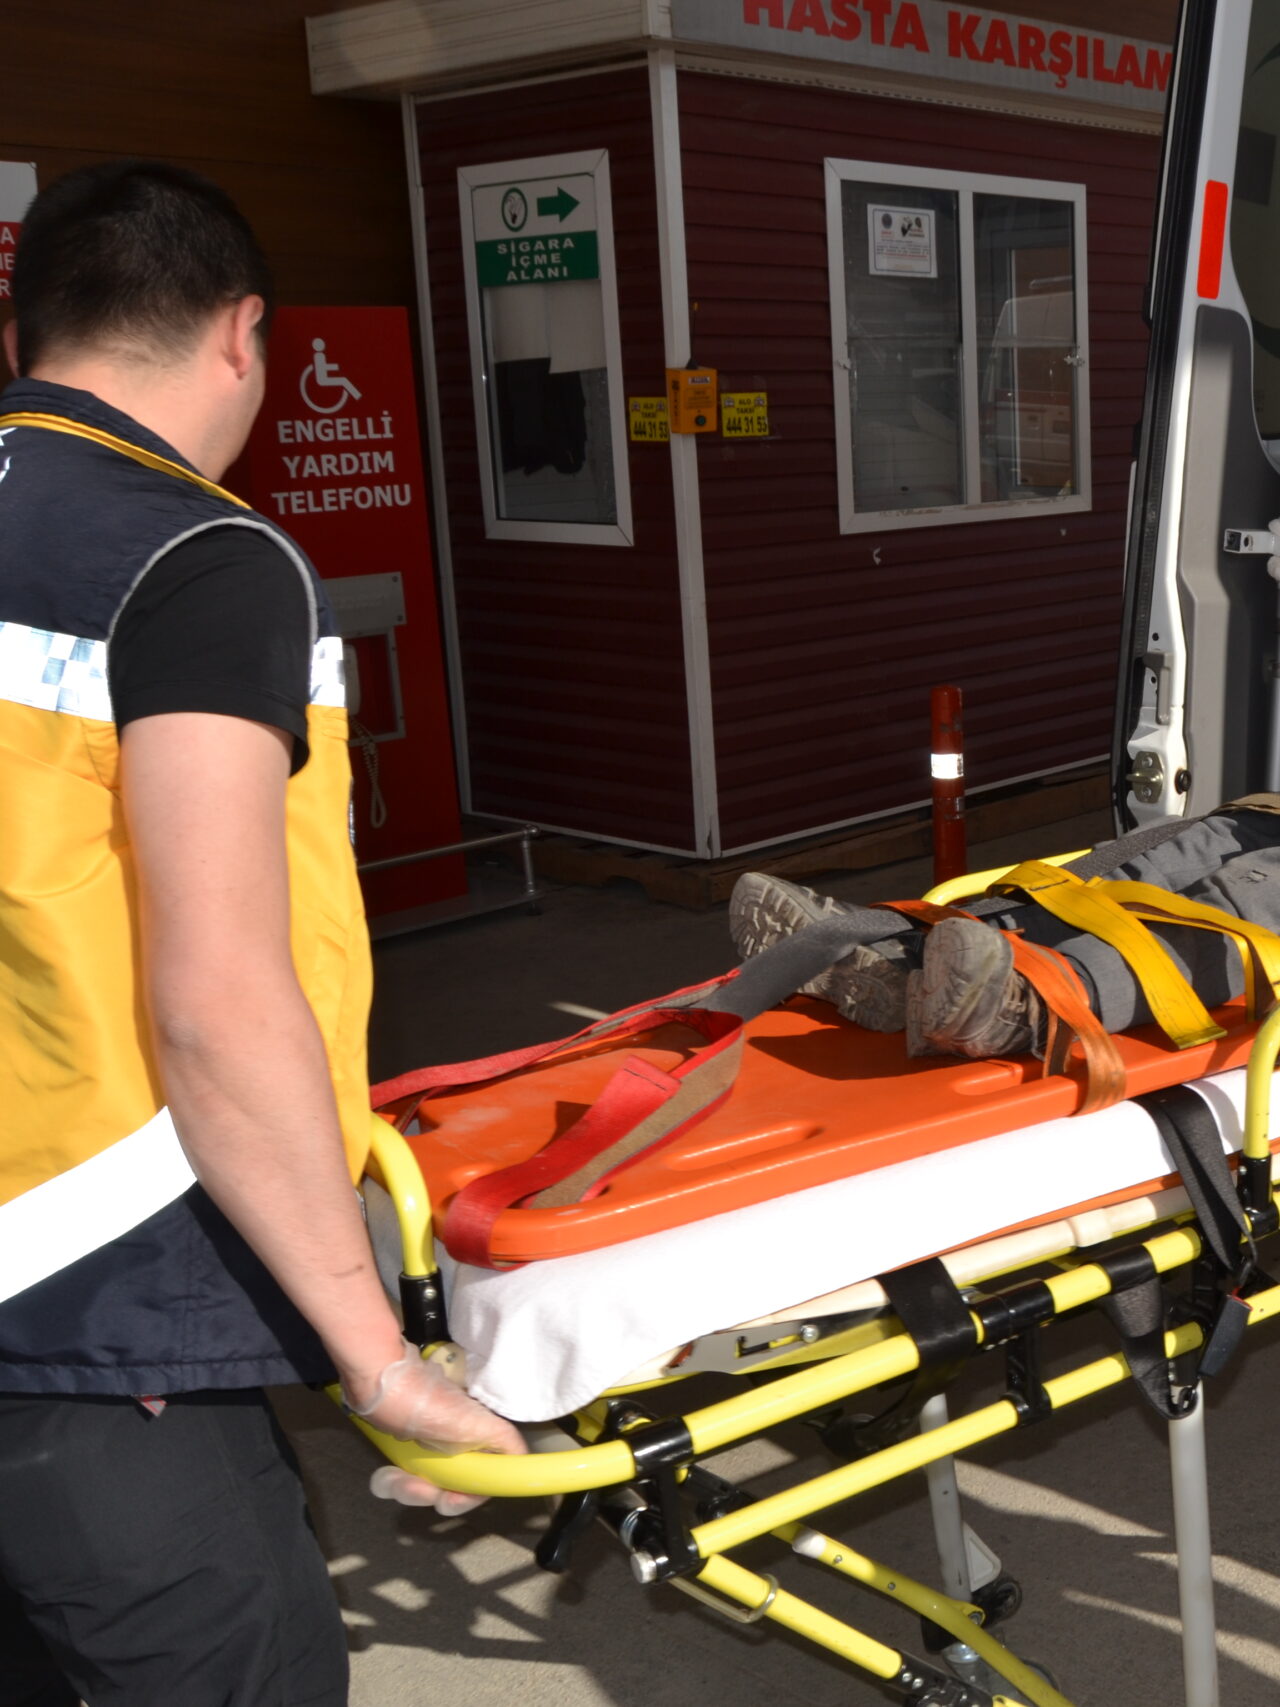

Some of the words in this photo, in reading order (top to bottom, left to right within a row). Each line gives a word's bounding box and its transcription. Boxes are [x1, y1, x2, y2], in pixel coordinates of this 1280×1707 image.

[743, 0, 930, 53] HASTA
[497, 237, 575, 255] SİGARA
[511, 252, 563, 269] İÇME
[506, 266, 569, 282] ALANI
[276, 410, 394, 444] ENGELLİ
[634, 421, 647, 436] 444
[647, 421, 657, 437] 31
[726, 417, 742, 432] 444
[744, 417, 754, 433] 31
[281, 450, 395, 480] YARDIM
[270, 483, 412, 516] TELEFONU
